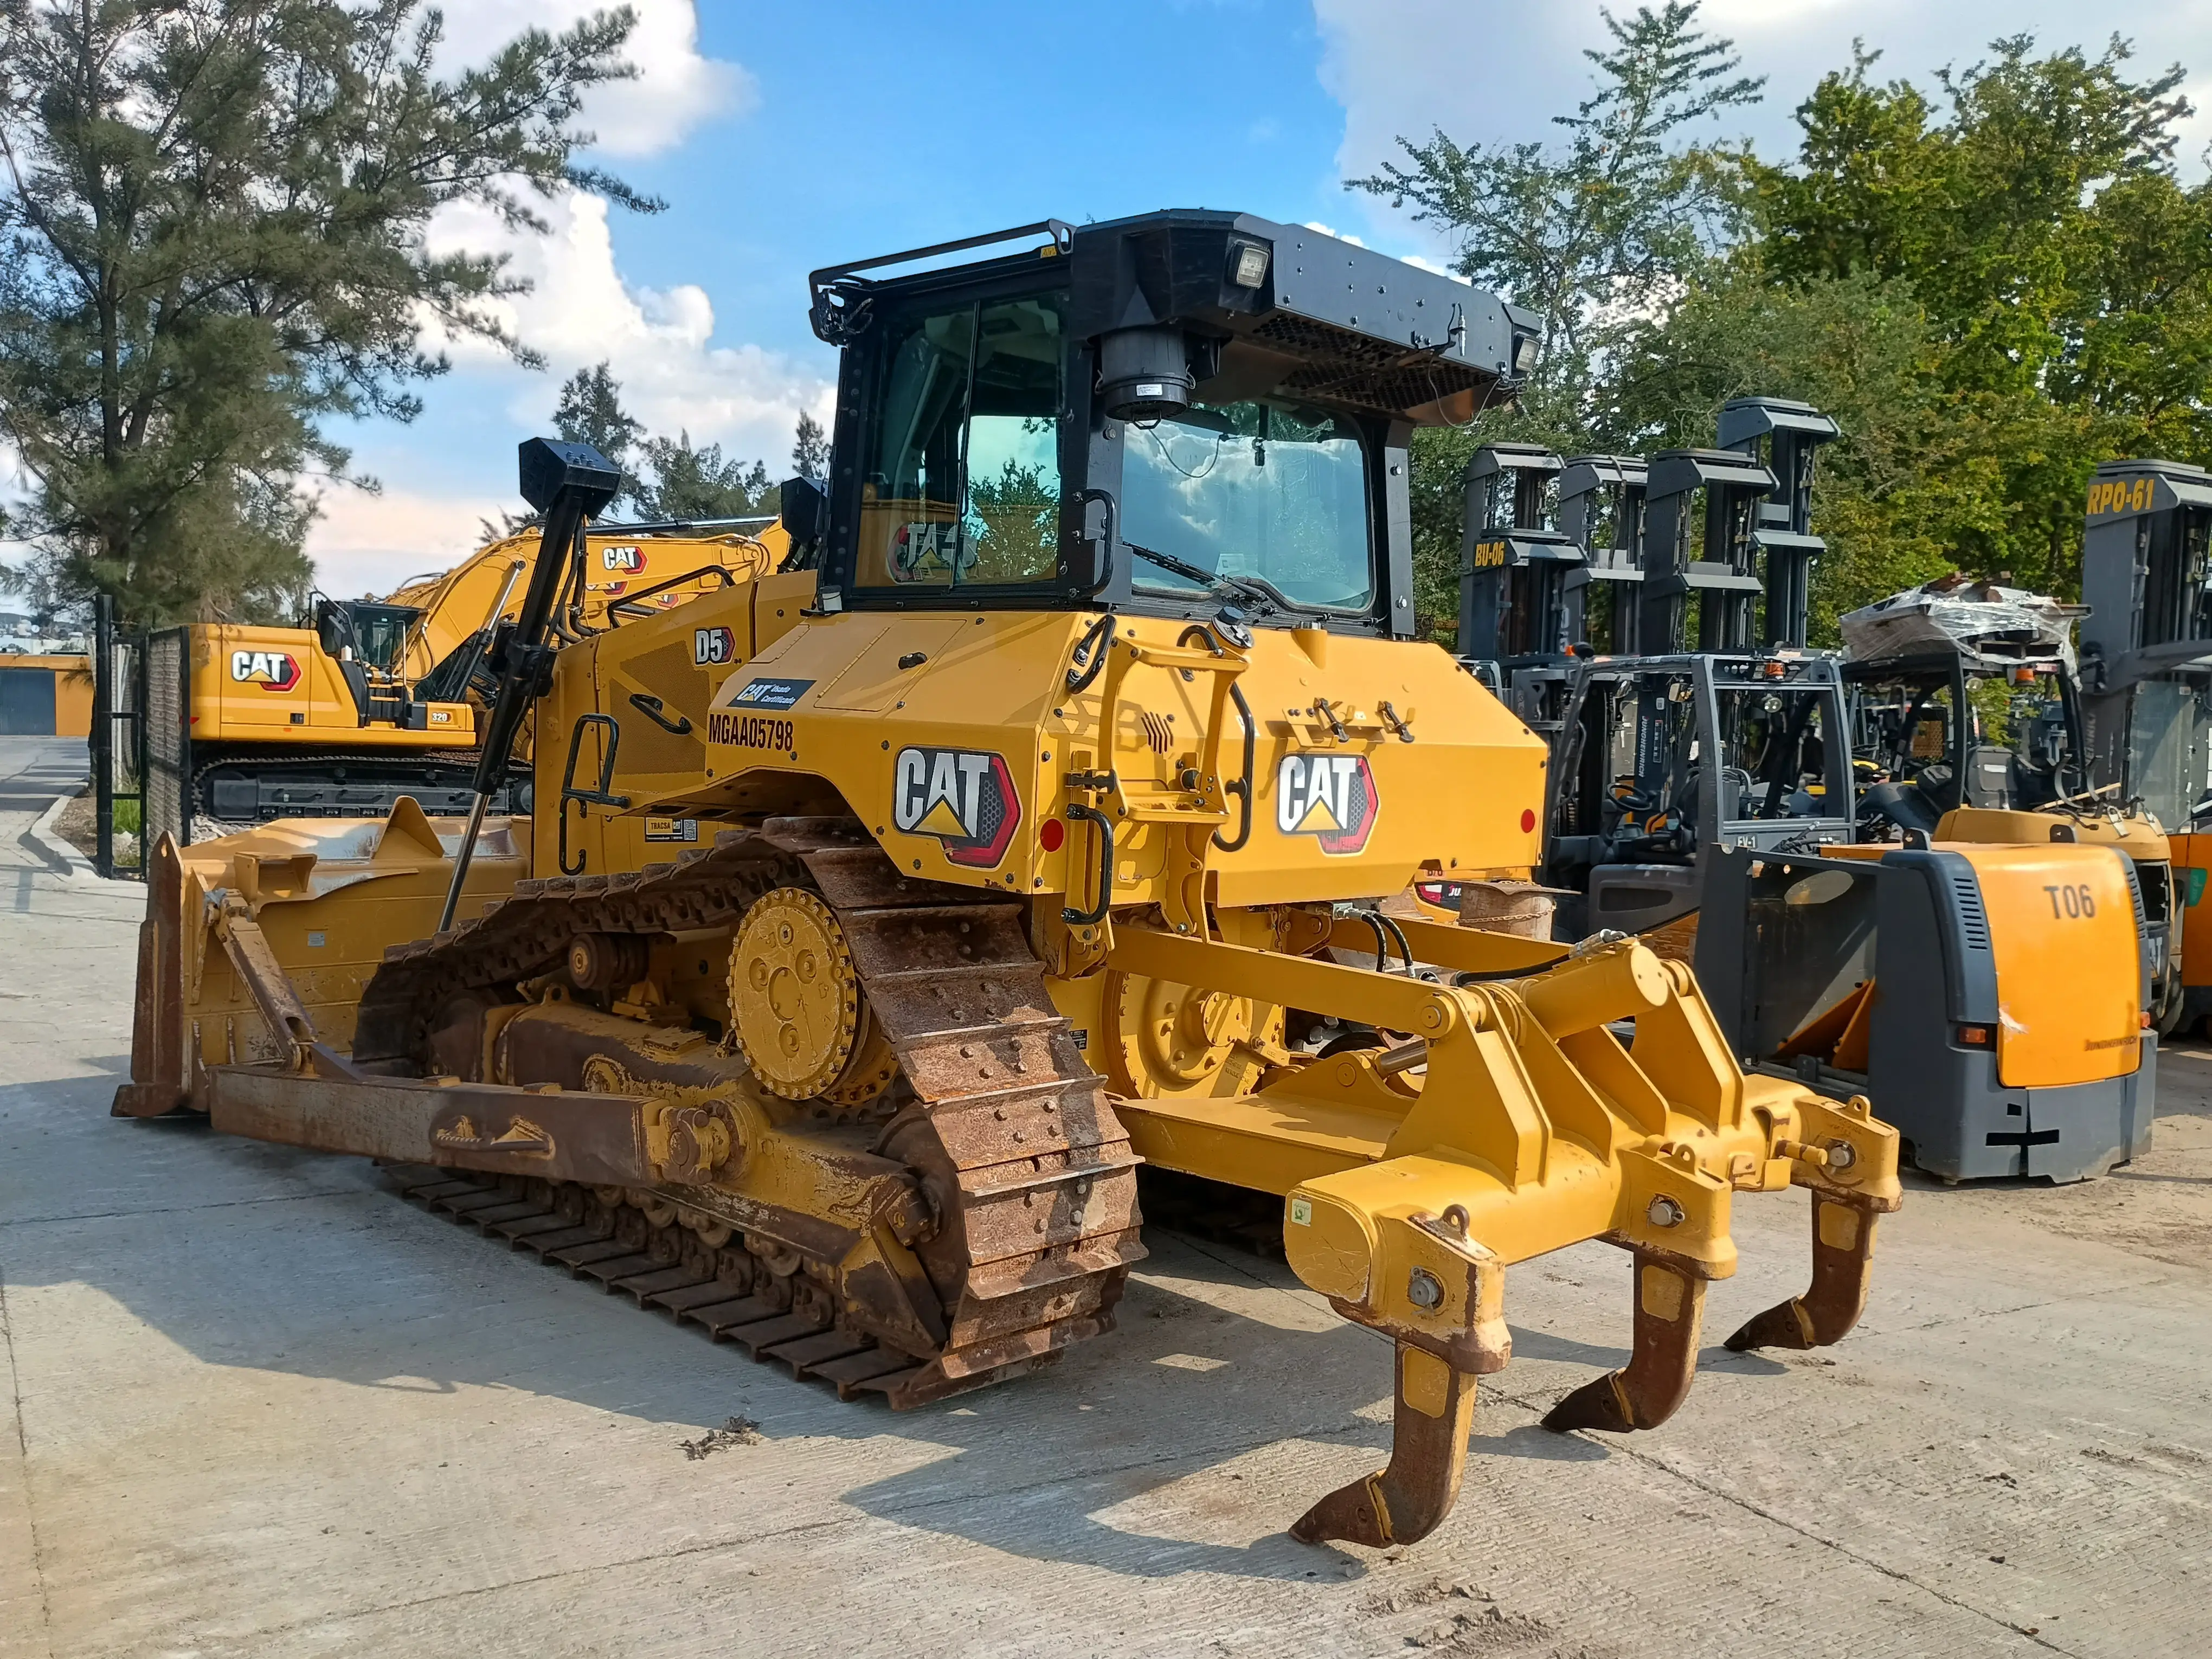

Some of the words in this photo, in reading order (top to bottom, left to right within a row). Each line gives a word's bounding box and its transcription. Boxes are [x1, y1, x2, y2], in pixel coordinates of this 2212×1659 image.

[2087, 479, 2155, 515] RPO-61
[603, 547, 635, 569] CAT
[1475, 541, 1505, 567] BU-06
[696, 629, 723, 663] D5
[233, 651, 285, 683] CAT
[737, 684, 774, 702] CAT
[760, 695, 796, 704] Certificado
[432, 712, 448, 722] 320
[709, 713, 794, 751] MGAA05798
[1638, 715, 1649, 777] JUNGHEINRICH
[896, 749, 989, 838] CAT
[1278, 756, 1356, 831] CAT
[2043, 884, 2095, 919] T06
